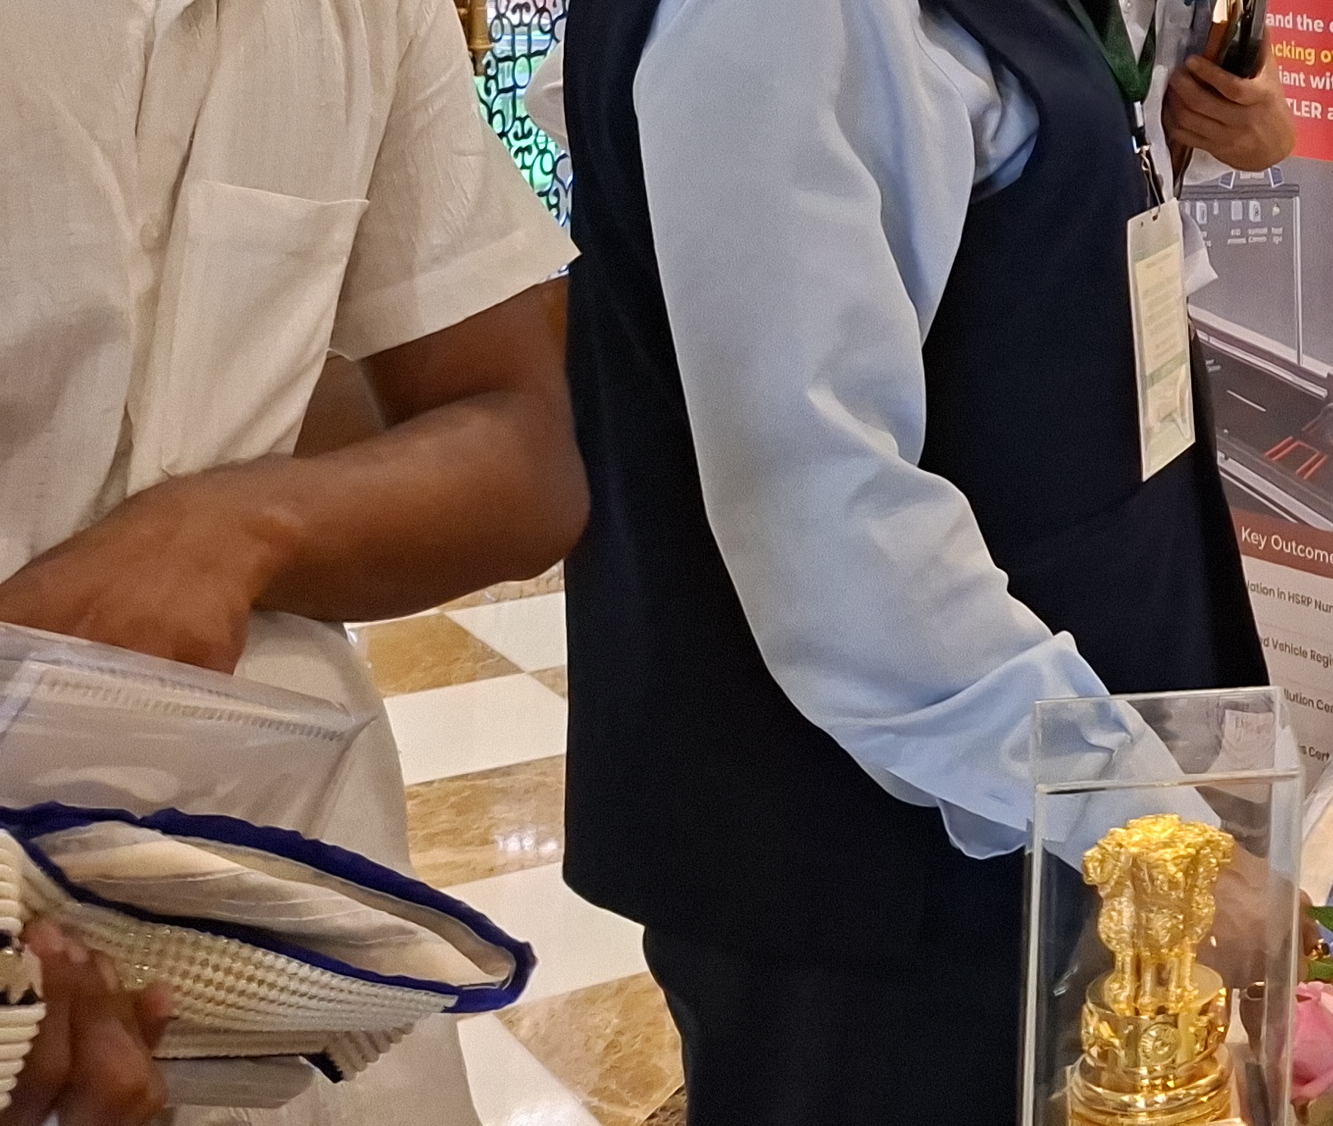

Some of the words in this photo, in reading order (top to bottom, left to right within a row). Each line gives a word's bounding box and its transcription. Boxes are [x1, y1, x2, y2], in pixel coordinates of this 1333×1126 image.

[1266, 11, 1292, 29] and
[1296, 13, 1324, 32] the
[1241, 526, 1267, 550] Key
[1271, 637, 1309, 660] Vehicle
